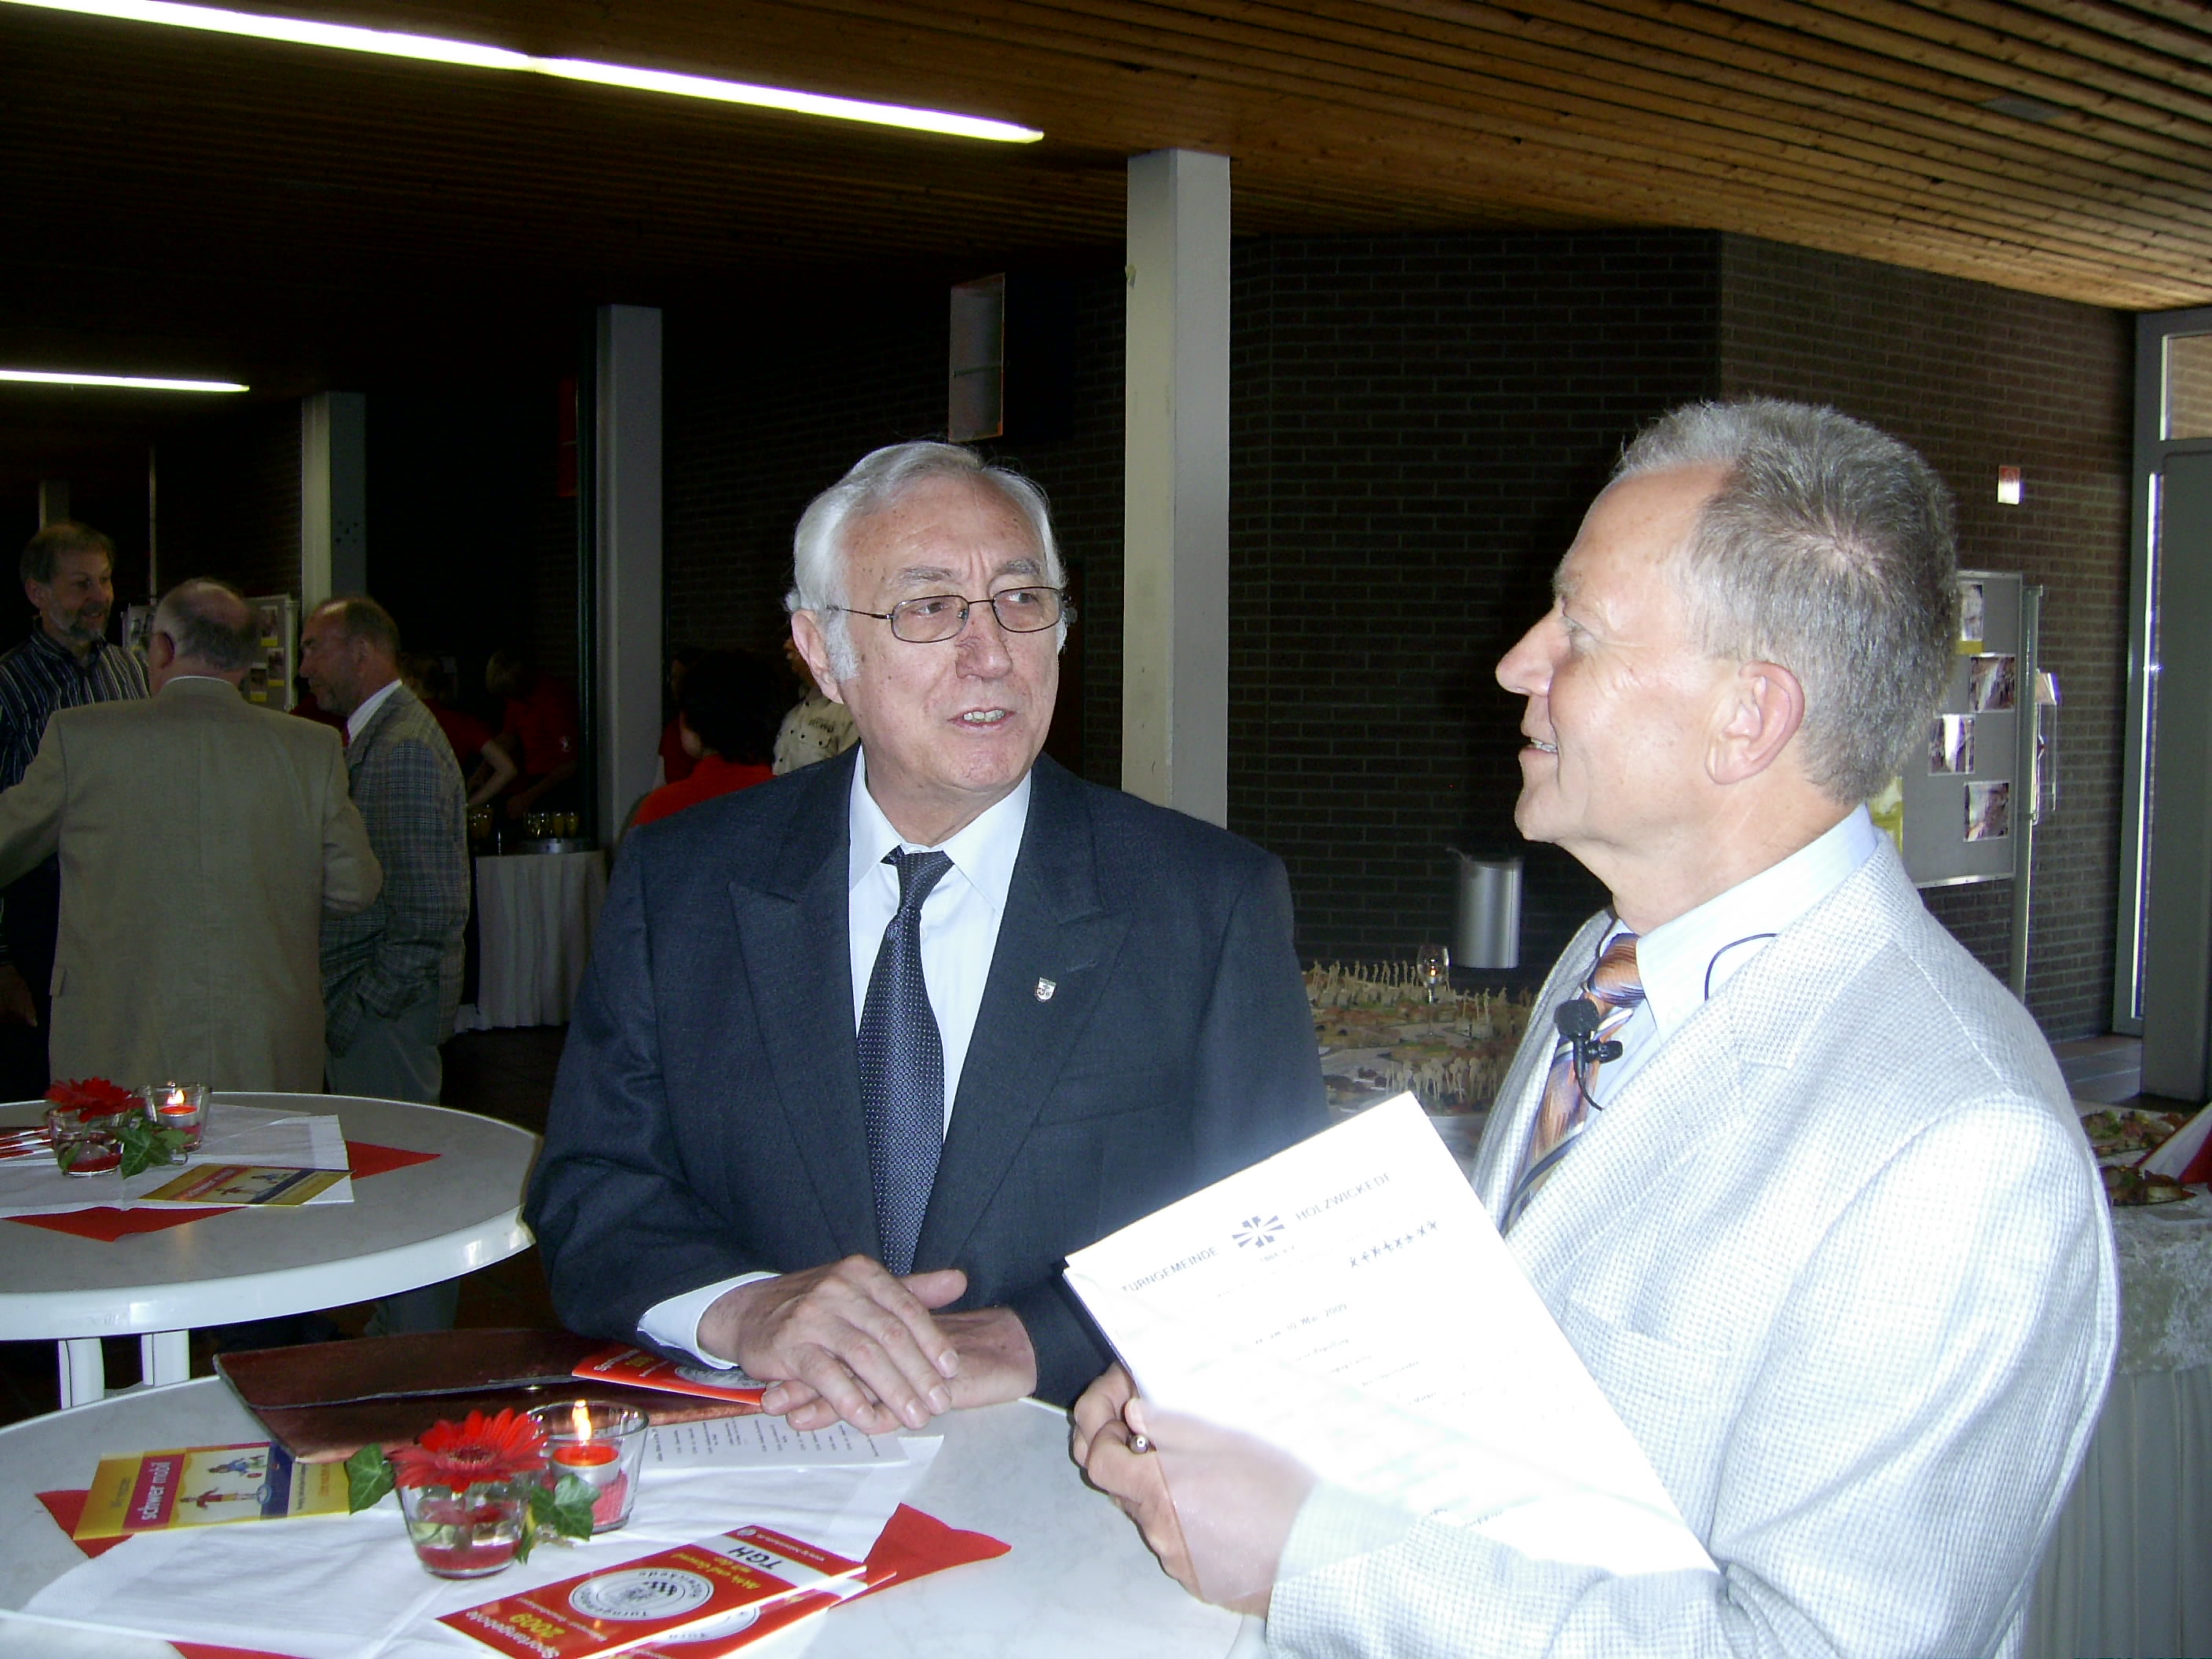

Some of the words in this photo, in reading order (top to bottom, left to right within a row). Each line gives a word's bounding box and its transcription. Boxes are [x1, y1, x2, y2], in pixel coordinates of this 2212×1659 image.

[1122, 1246, 1218, 1294] TURNGEMEINDE
[1295, 1172, 1390, 1221] HOLZWICKEDE
[147, 1460, 171, 1486] mobil
[137, 1485, 166, 1521] schwer
[727, 1547, 782, 1569] TGH
